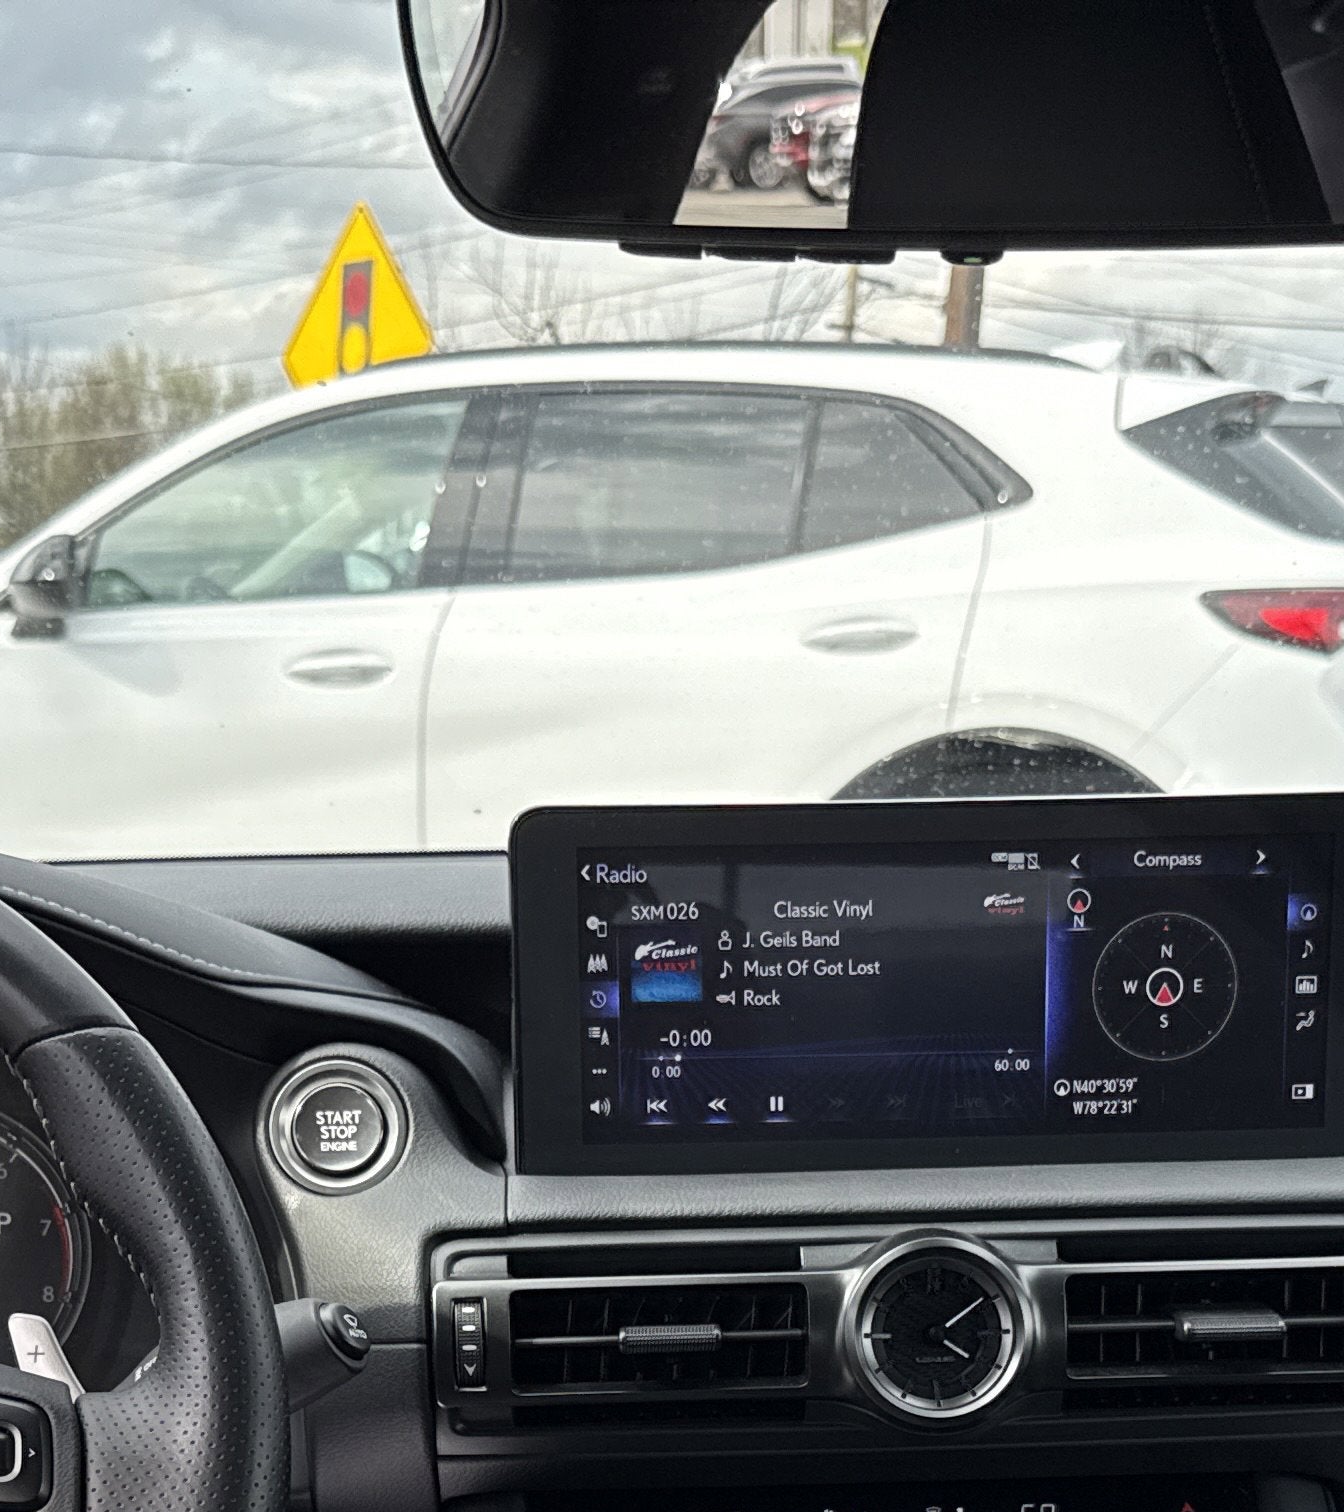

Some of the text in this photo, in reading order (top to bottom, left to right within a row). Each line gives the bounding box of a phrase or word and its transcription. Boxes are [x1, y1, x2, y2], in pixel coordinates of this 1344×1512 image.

[1133, 851, 1203, 869] Compass
[596, 864, 647, 884] Radio
[631, 902, 699, 921] SXM 026
[774, 899, 873, 920] Classic Vinyl
[1072, 915, 1086, 928] N
[743, 930, 840, 949] J. Geils Band
[651, 944, 698, 960] Classic
[1160, 944, 1173, 960] N
[743, 959, 881, 978] Must Of Got Lost
[1122, 979, 1138, 995] W
[1193, 978, 1203, 993] E
[743, 989, 781, 1007] Rock
[1159, 1014, 1169, 1029] S
[315, 1109, 362, 1125] START
[320, 1125, 358, 1139] STOP
[320, 1141, 358, 1151] ENGINE
[39, 1219, 52, 1237] 7
[42, 1285, 55, 1303] 8
